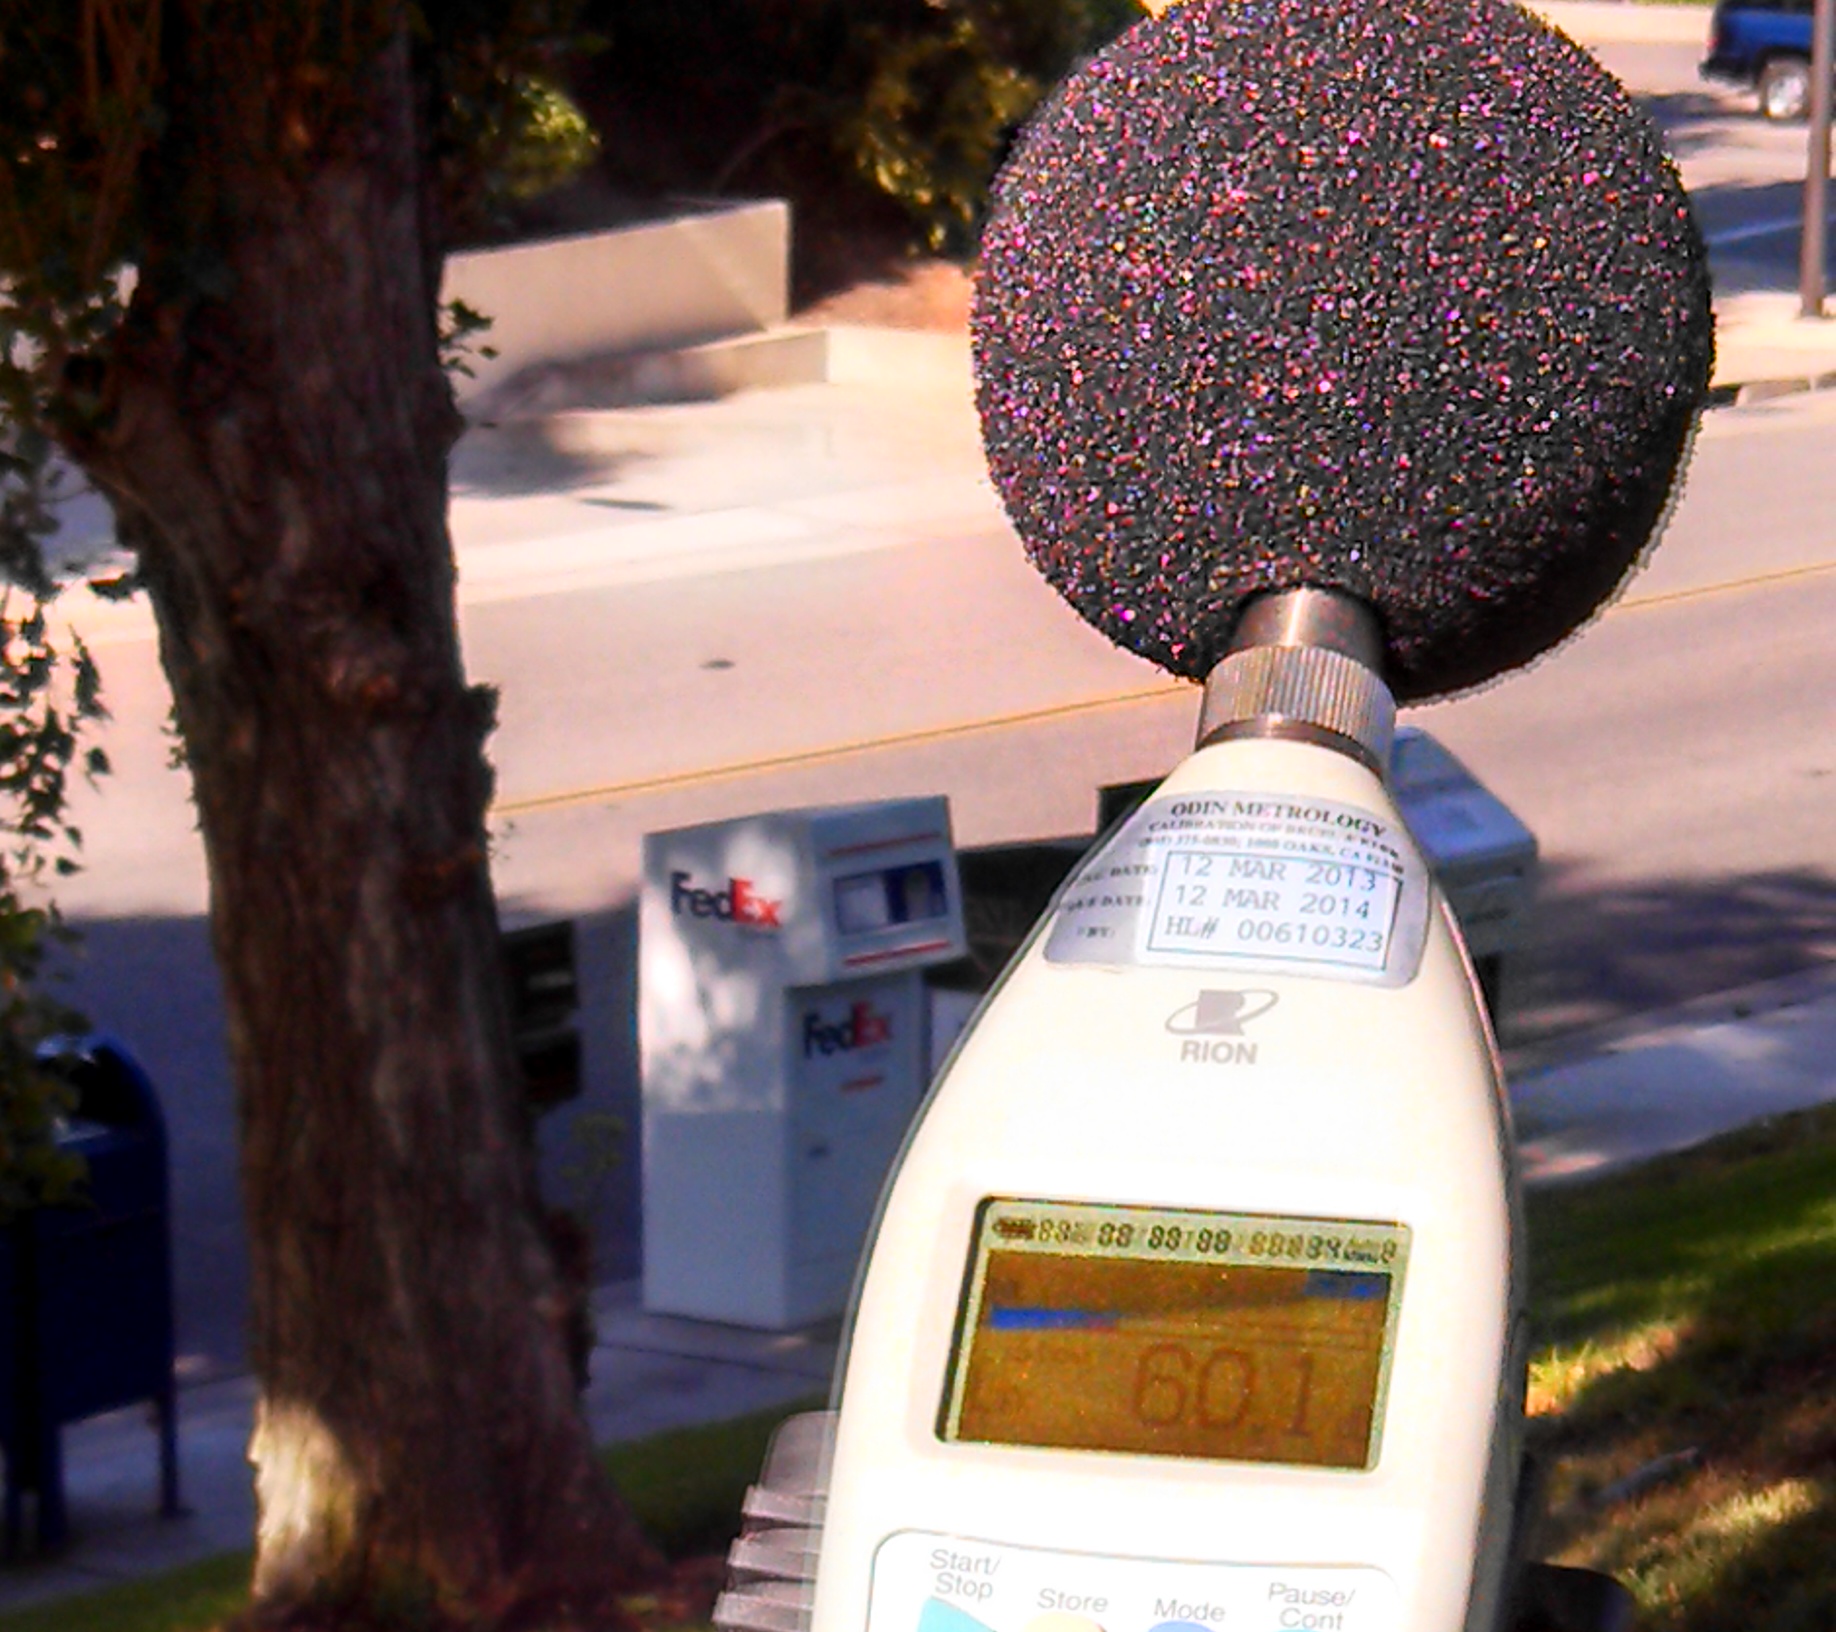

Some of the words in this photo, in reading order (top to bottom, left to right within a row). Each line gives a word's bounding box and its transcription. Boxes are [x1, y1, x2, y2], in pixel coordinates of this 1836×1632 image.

[1170, 801, 1226, 818] ODIN
[1233, 801, 1386, 837] METROLOGY
[1183, 854, 1213, 877] 12
[1228, 857, 1286, 881] MAR
[1305, 862, 1376, 891] 2013
[671, 871, 782, 928] FedEx
[1176, 885, 1207, 907] 12
[1221, 887, 1281, 911] MAR
[1299, 892, 1370, 919] 2014
[1164, 915, 1219, 939] HL#
[1237, 919, 1383, 952] 00610323
[804, 1001, 892, 1059] FedEx
[1180, 1040, 1258, 1065] RION
[929, 1548, 1001, 1575] Start/
[935, 1572, 994, 1602] Stop
[1037, 1588, 1109, 1613] Store
[1268, 1582, 1356, 1606] Pause/
[1154, 1598, 1226, 1622] Mode
[1279, 1607, 1344, 1630] Cont
